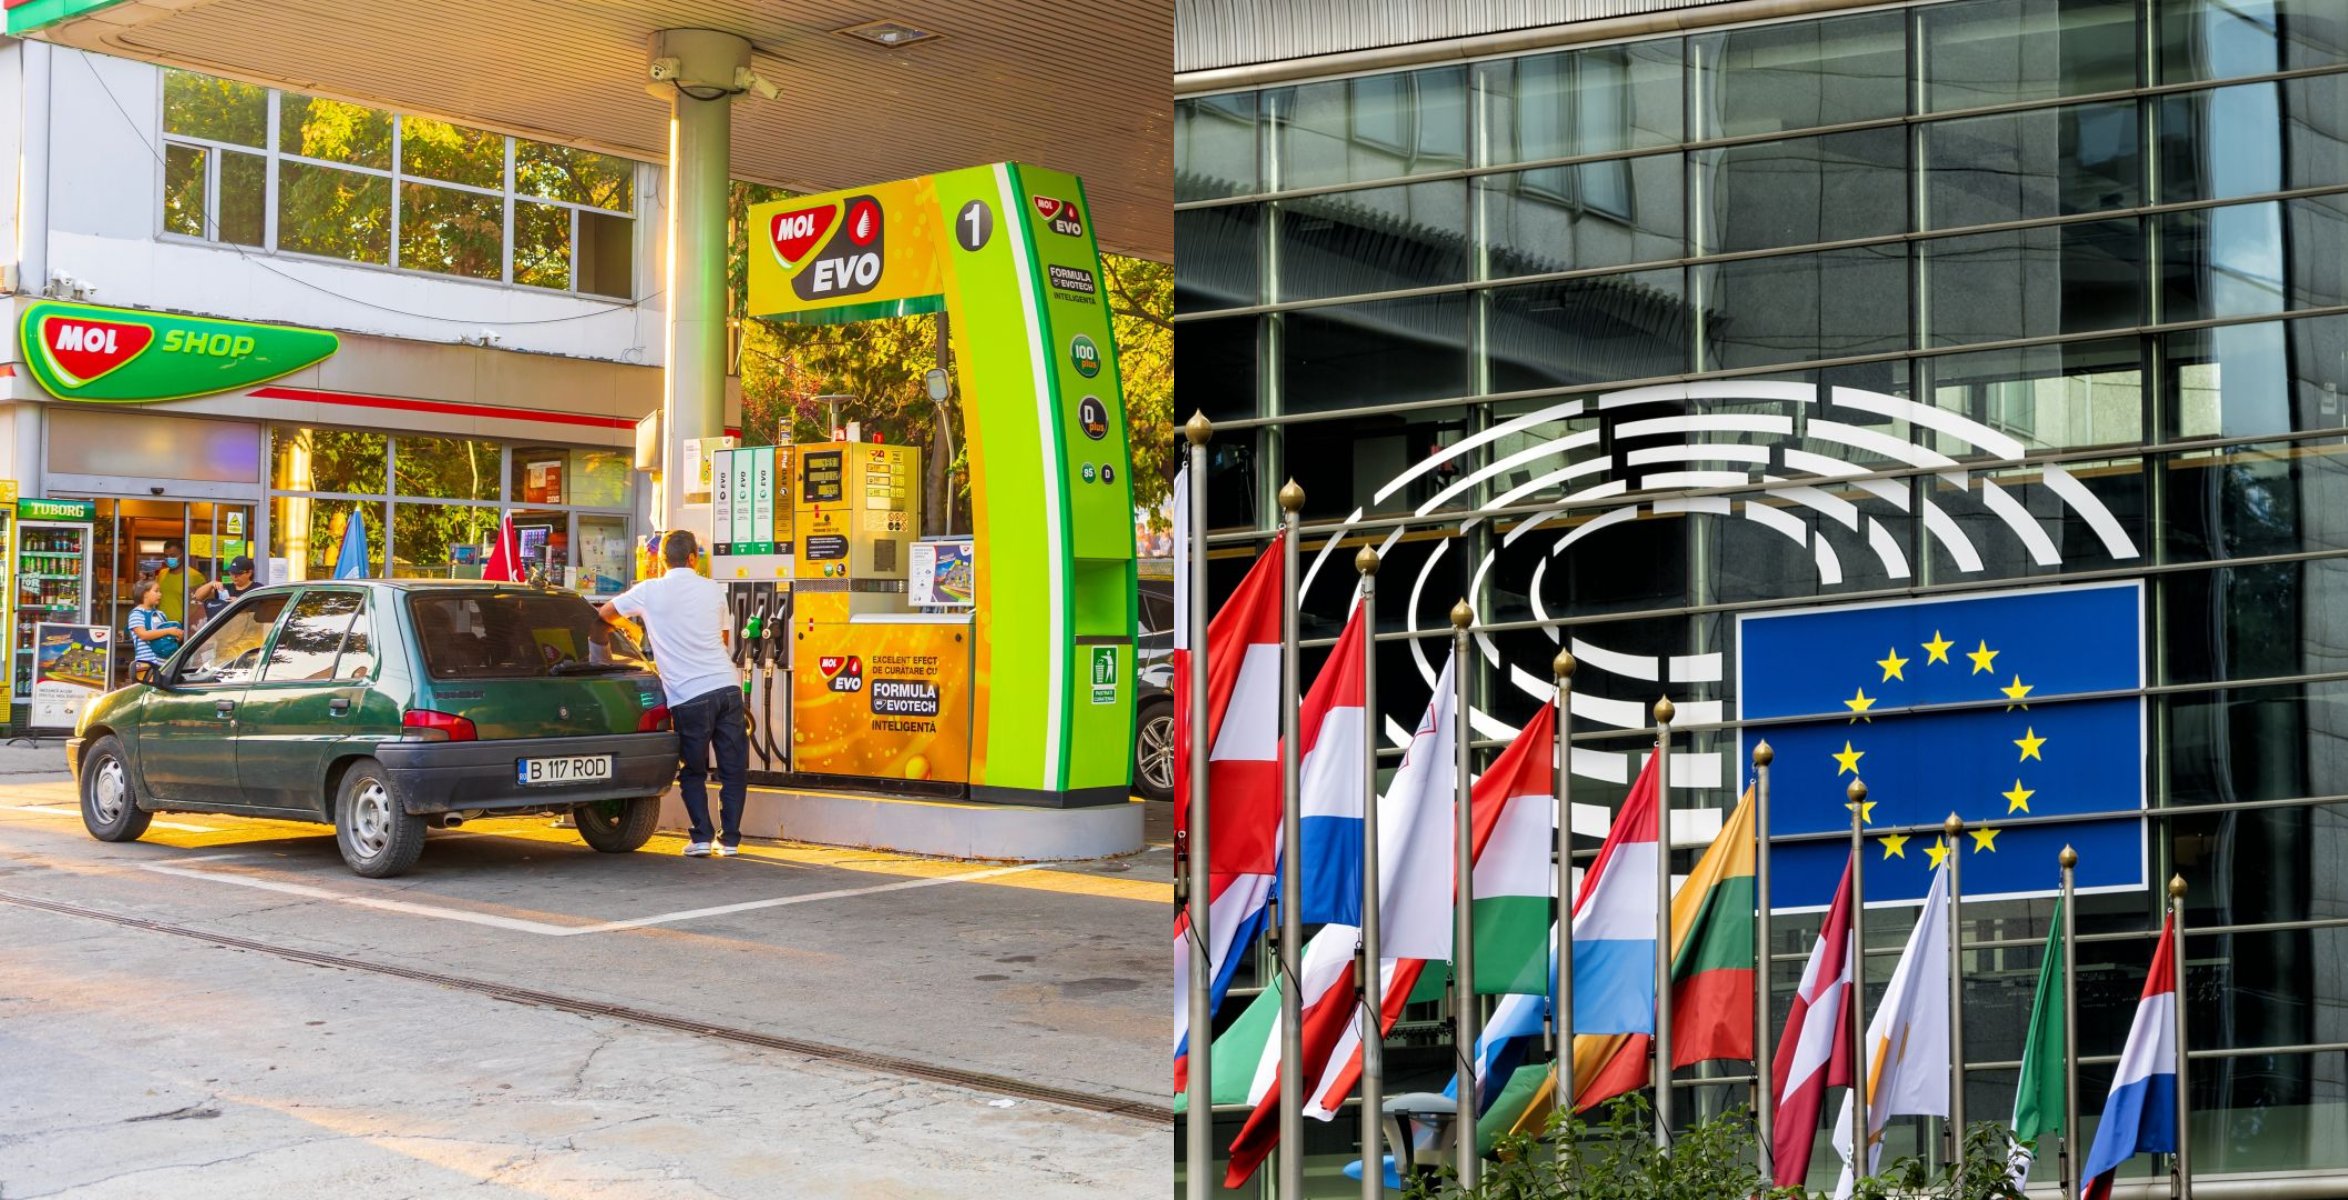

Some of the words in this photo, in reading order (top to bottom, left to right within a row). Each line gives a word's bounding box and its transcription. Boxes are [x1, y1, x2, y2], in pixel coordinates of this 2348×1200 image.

[1038, 199, 1053, 209] MOL
[777, 213, 815, 241] MOL
[963, 204, 981, 246] 1
[1056, 220, 1081, 235] EVO
[812, 252, 881, 292] EVO
[1050, 267, 1091, 282] FORMULA
[1061, 280, 1093, 291] EVOTECH
[56, 324, 119, 354] MOL
[162, 329, 255, 358] SHOP
[1075, 344, 1094, 360] 100
[1081, 359, 1097, 369] plus
[1084, 405, 1095, 423] D
[1088, 421, 1105, 433] plus
[1084, 469, 1094, 478] 95
[1105, 469, 1111, 478] D
[31, 502, 84, 517] TUBORG
[872, 656, 910, 664] EXCELENT
[913, 657, 938, 665] EFECT
[872, 666, 882, 674] DE
[926, 667, 937, 675] CU
[835, 677, 861, 690] EVO
[873, 683, 936, 698] FORMULA
[886, 700, 936, 713] EVOTECH
[531, 762, 542, 779] B
[548, 760, 568, 778] 117
[573, 758, 606, 776] ROD
